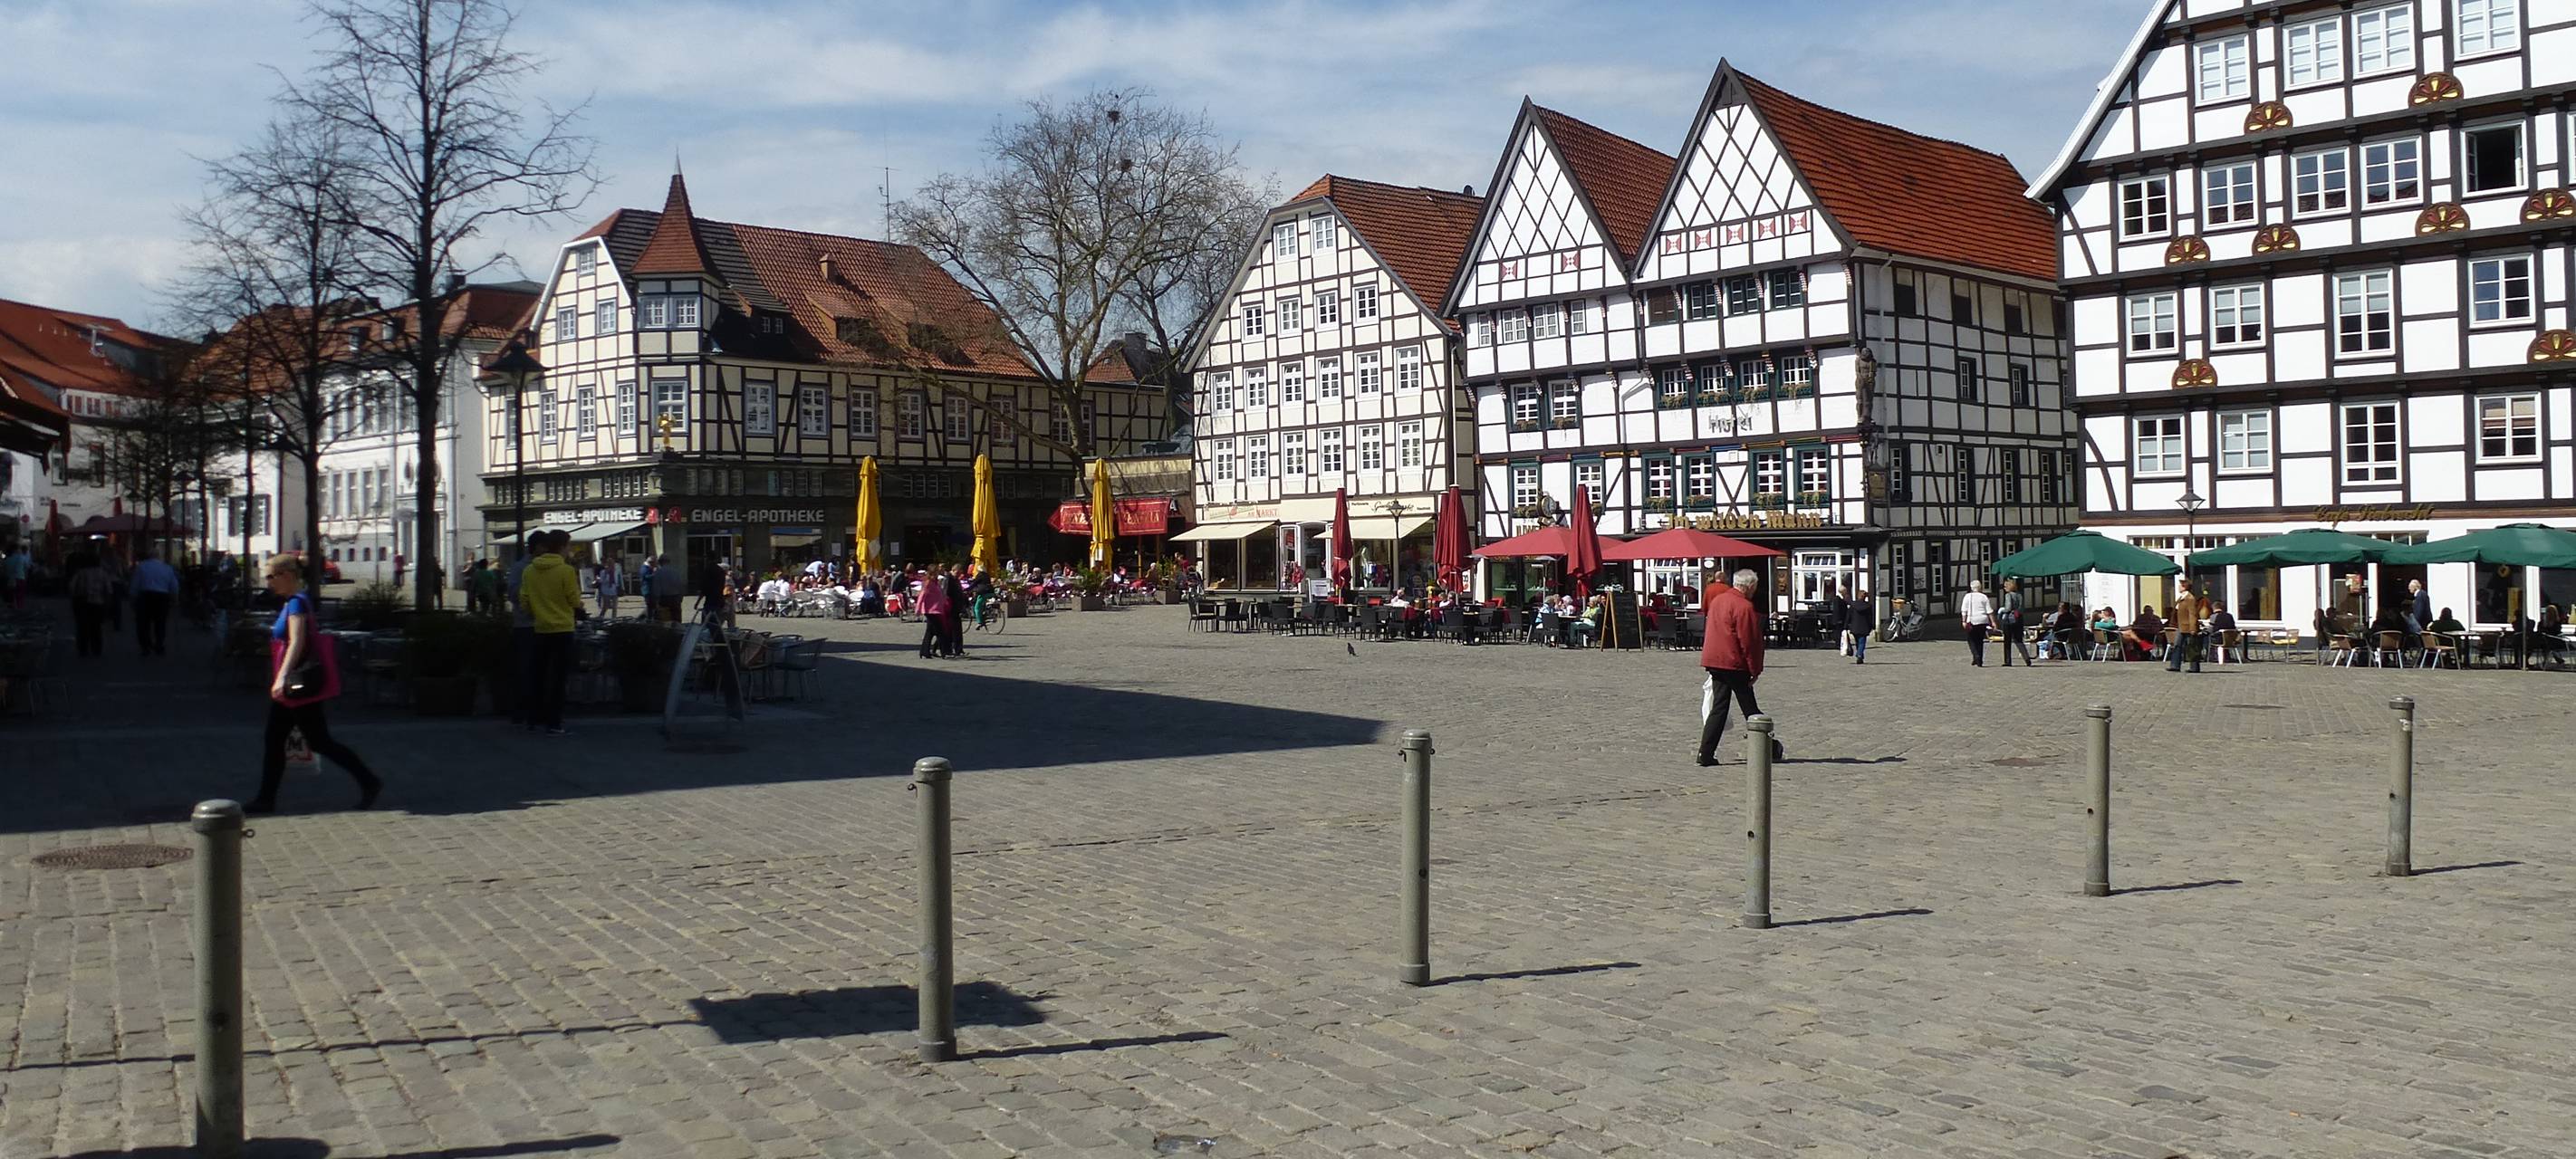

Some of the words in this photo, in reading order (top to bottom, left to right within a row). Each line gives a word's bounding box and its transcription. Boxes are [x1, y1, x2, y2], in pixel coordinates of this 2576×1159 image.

[1708, 413, 1753, 433] Hotel
[543, 508, 644, 523] ENGEL-APOTHEKE
[691, 509, 825, 522] ENGEL-APOTHEKE
[1666, 513, 1690, 530] Im
[1696, 512, 1761, 530] wilden
[1766, 510, 1821, 529] Mann
